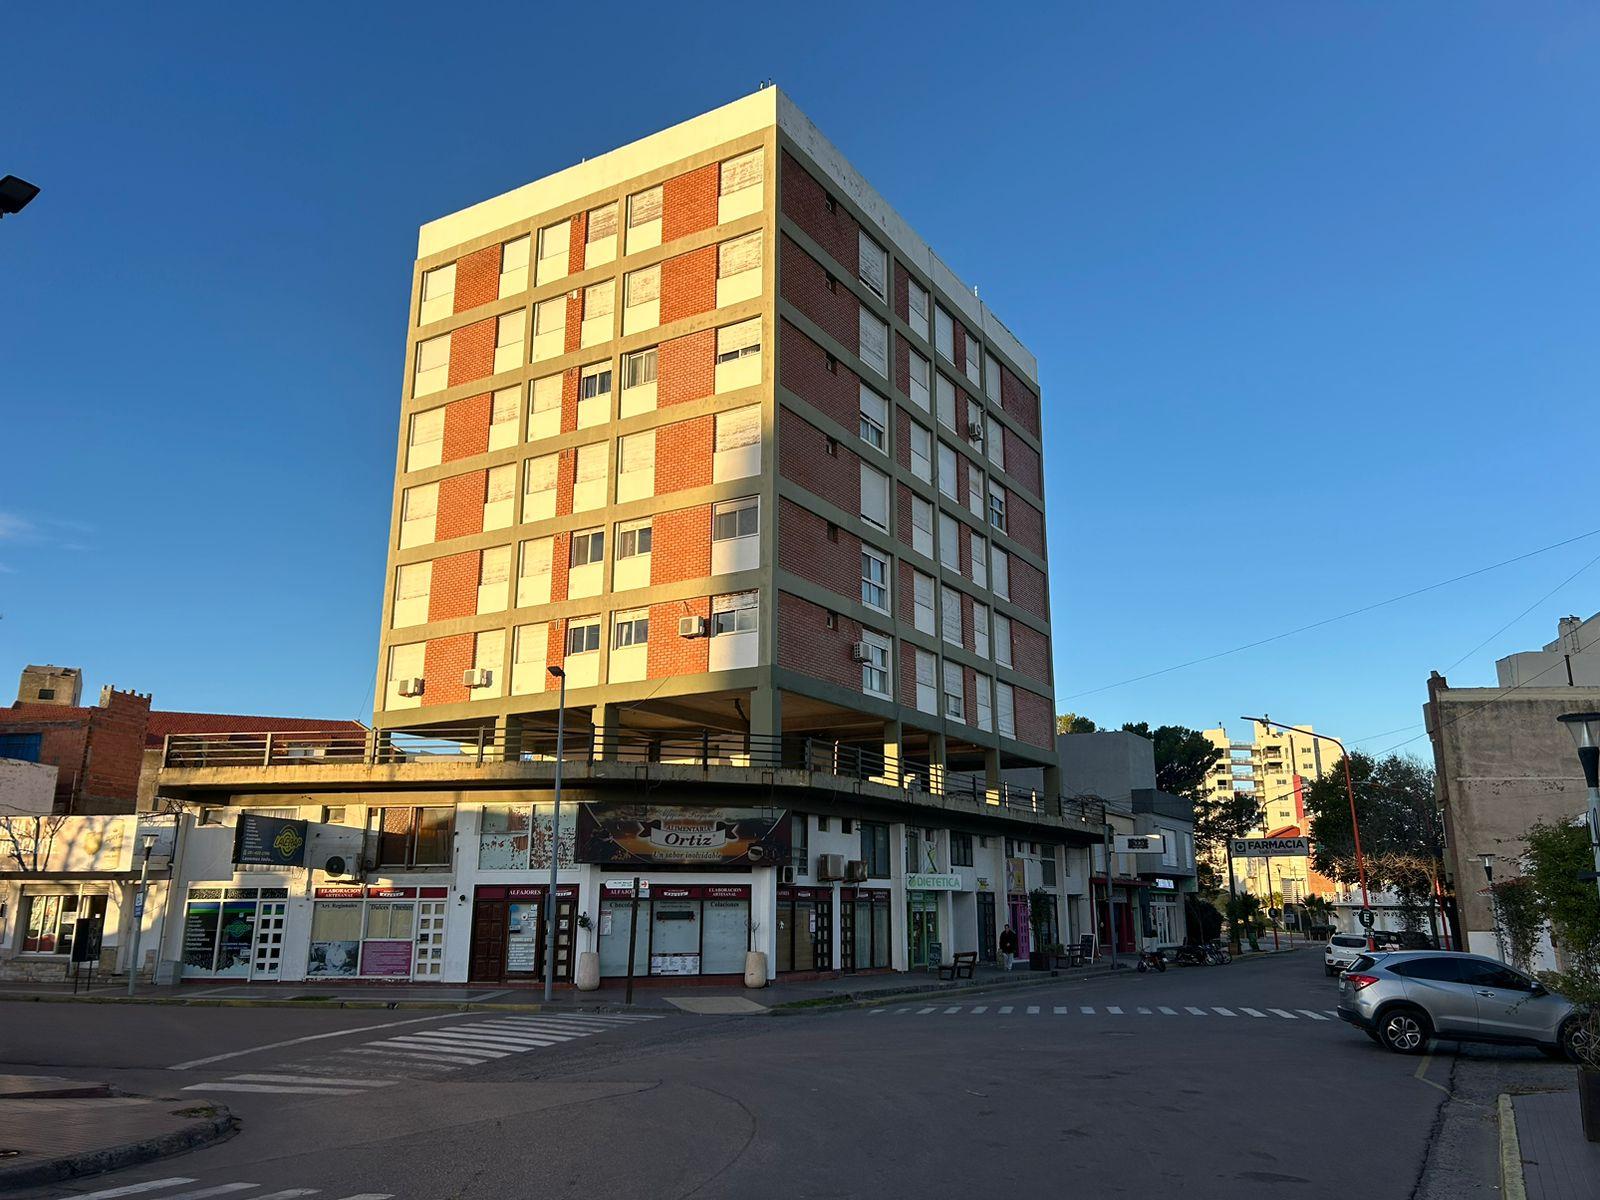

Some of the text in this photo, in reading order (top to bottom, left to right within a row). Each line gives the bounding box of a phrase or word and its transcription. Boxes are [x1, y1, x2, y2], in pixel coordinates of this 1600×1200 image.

[664, 832, 712, 846] Ortiz
[1248, 840, 1304, 849] FARMACIA
[685, 851, 721, 859] inolvidable
[1363, 913, 1370, 922] E
